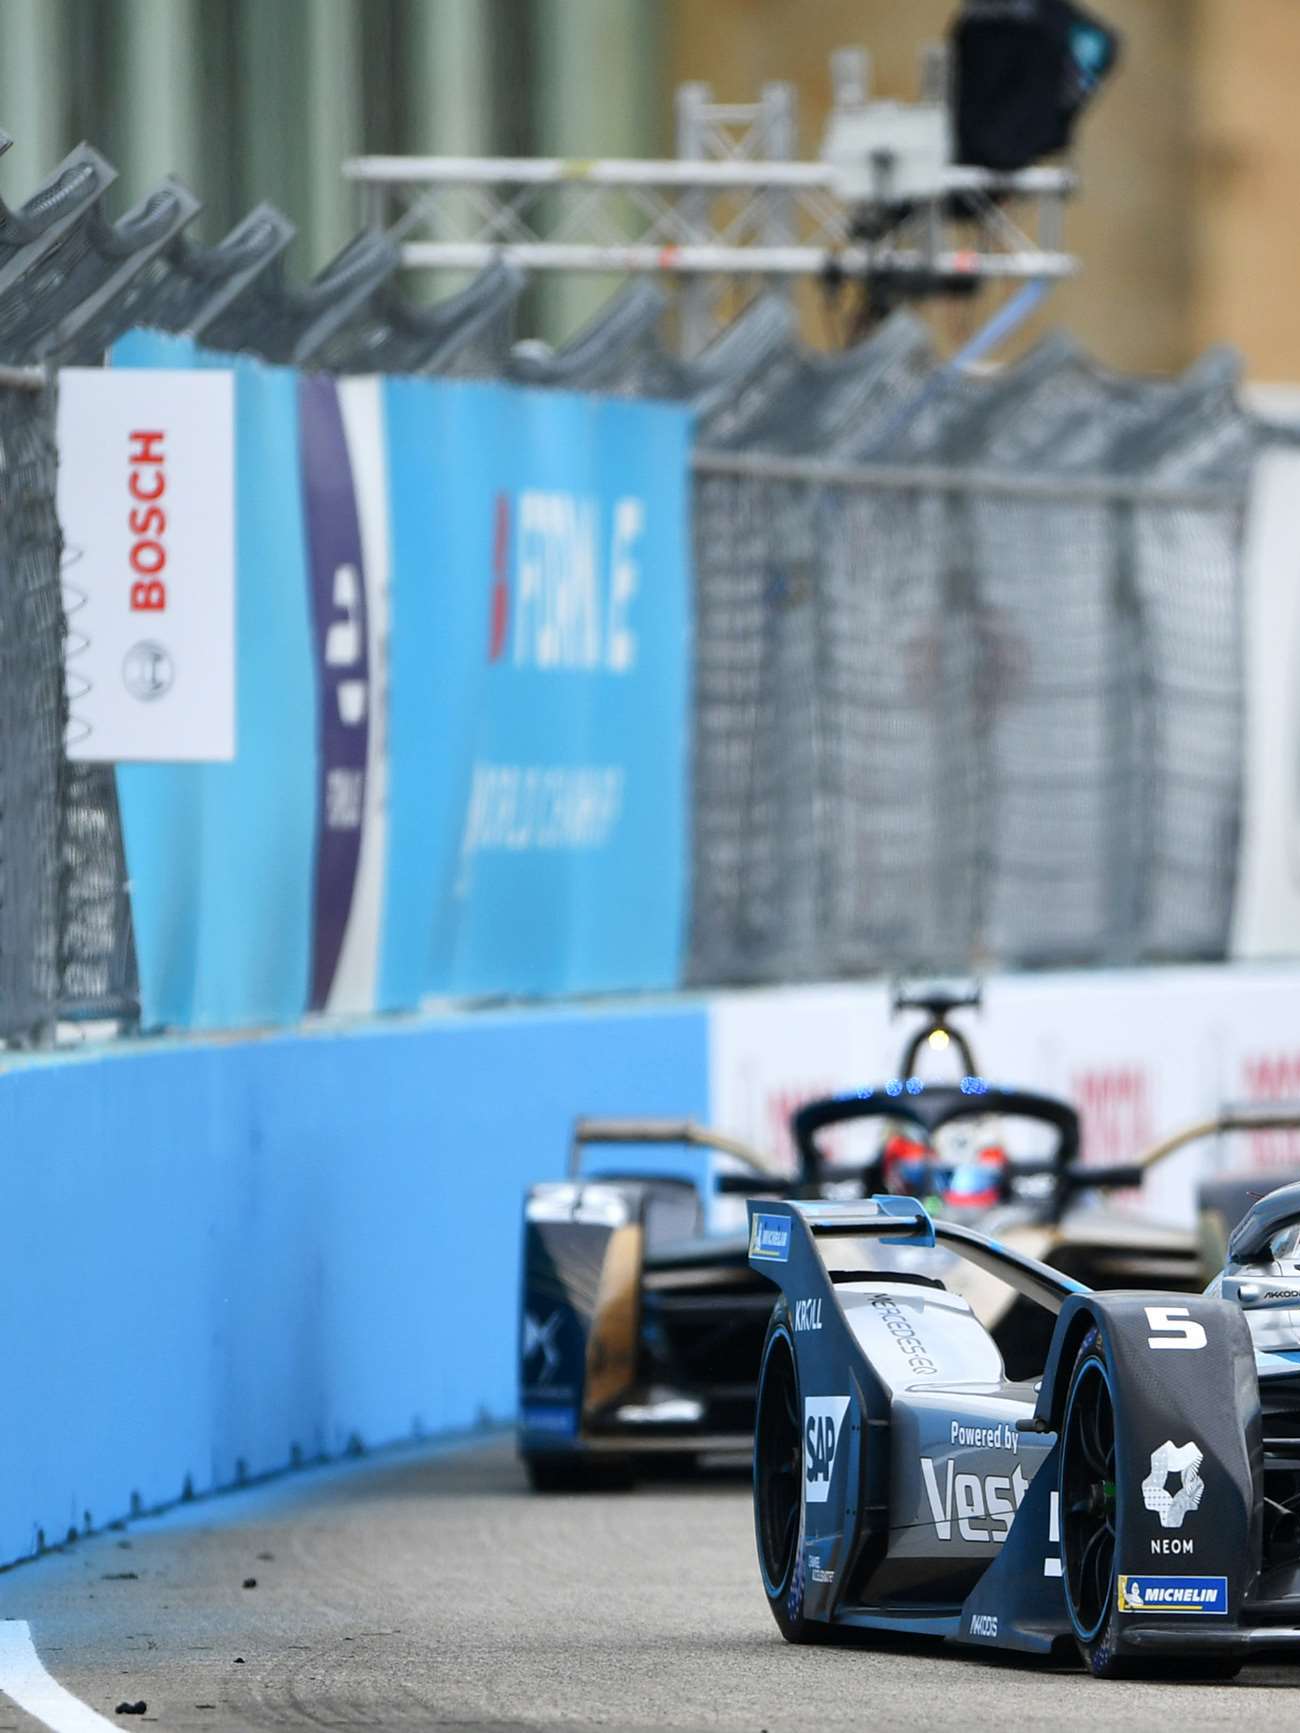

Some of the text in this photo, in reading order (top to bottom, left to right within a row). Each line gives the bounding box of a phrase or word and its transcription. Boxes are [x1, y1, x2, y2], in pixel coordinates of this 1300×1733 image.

[129, 430, 166, 612] BOSCH
[795, 1299, 822, 1332] KROLL
[1144, 1307, 1207, 1349] 5
[806, 1416, 835, 1483] SAP
[951, 1421, 1018, 1454] Powered by
[920, 1457, 1029, 1542] Vest
[1151, 1539, 1194, 1554] NEOM
[1145, 1588, 1217, 1602] MICHELIN
